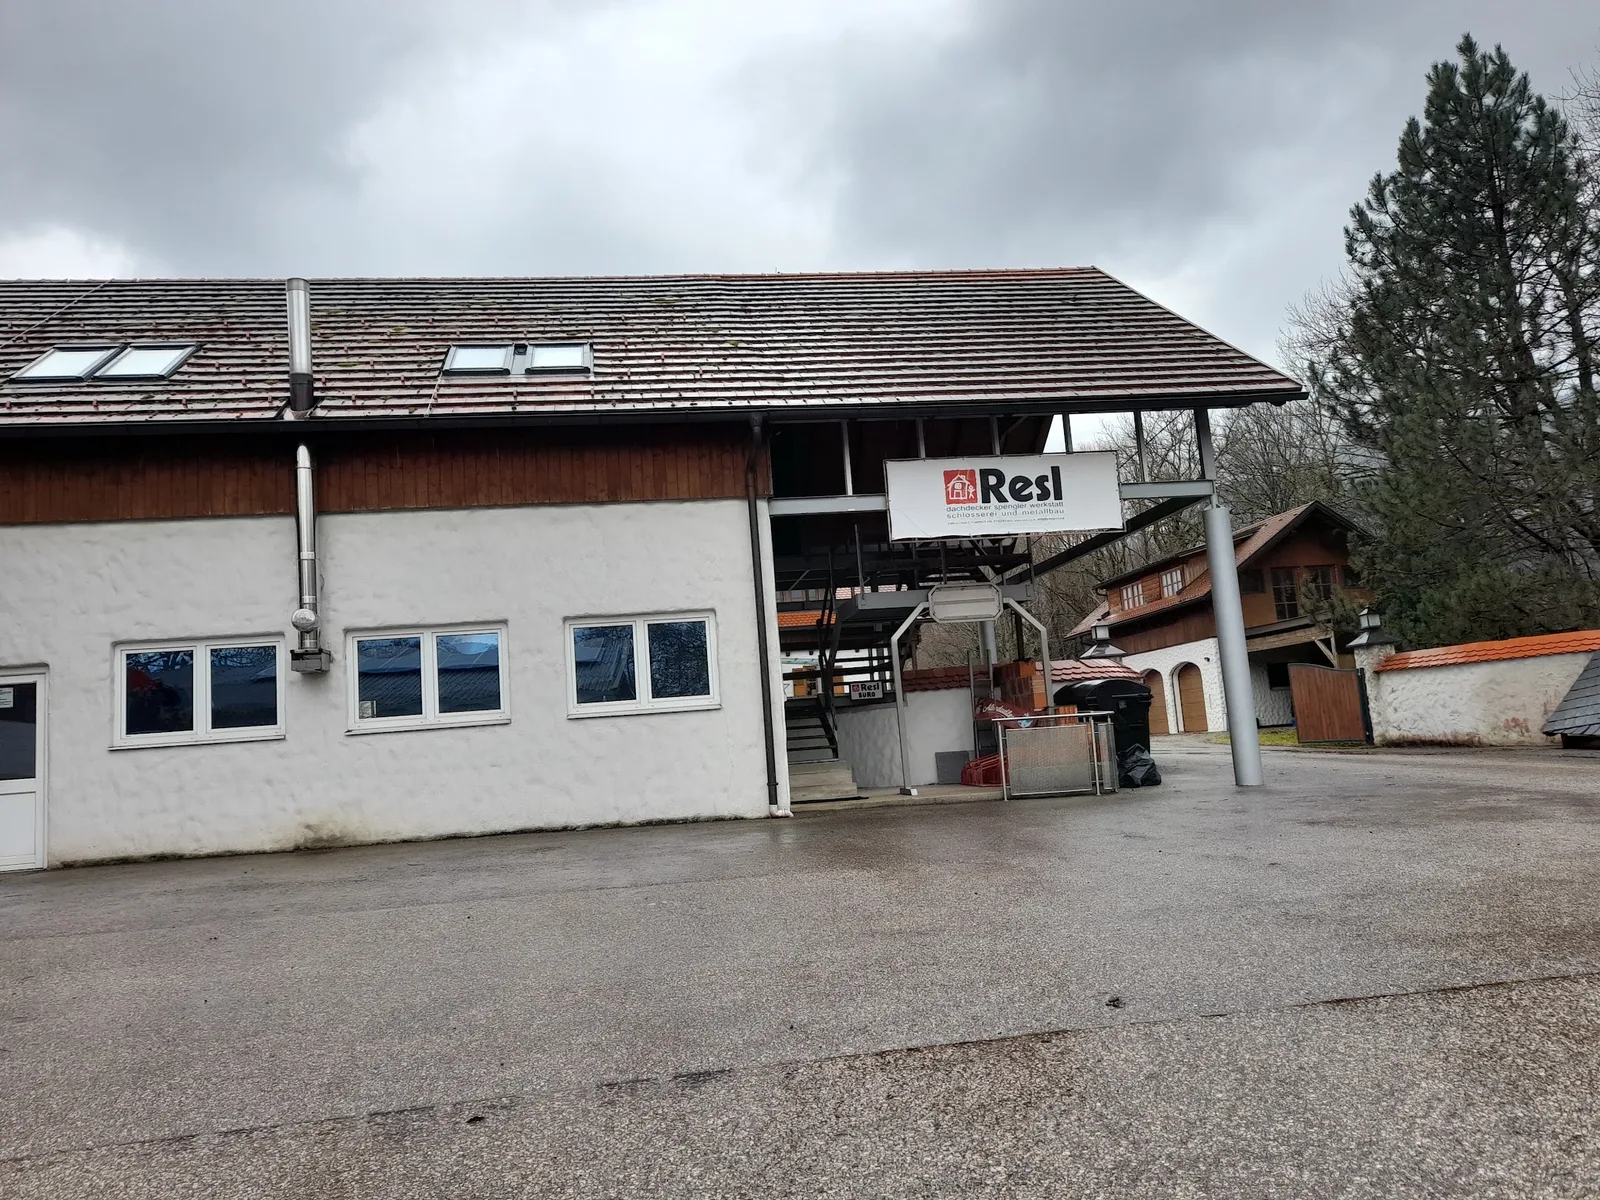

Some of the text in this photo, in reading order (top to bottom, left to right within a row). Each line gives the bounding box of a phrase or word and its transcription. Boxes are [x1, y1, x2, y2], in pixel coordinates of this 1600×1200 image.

[979, 466, 1063, 503] Resl
[946, 504, 991, 512] dachdecker
[994, 503, 1027, 511] spengler
[946, 511, 997, 519] schlosserei
[860, 682, 880, 691] Resl
